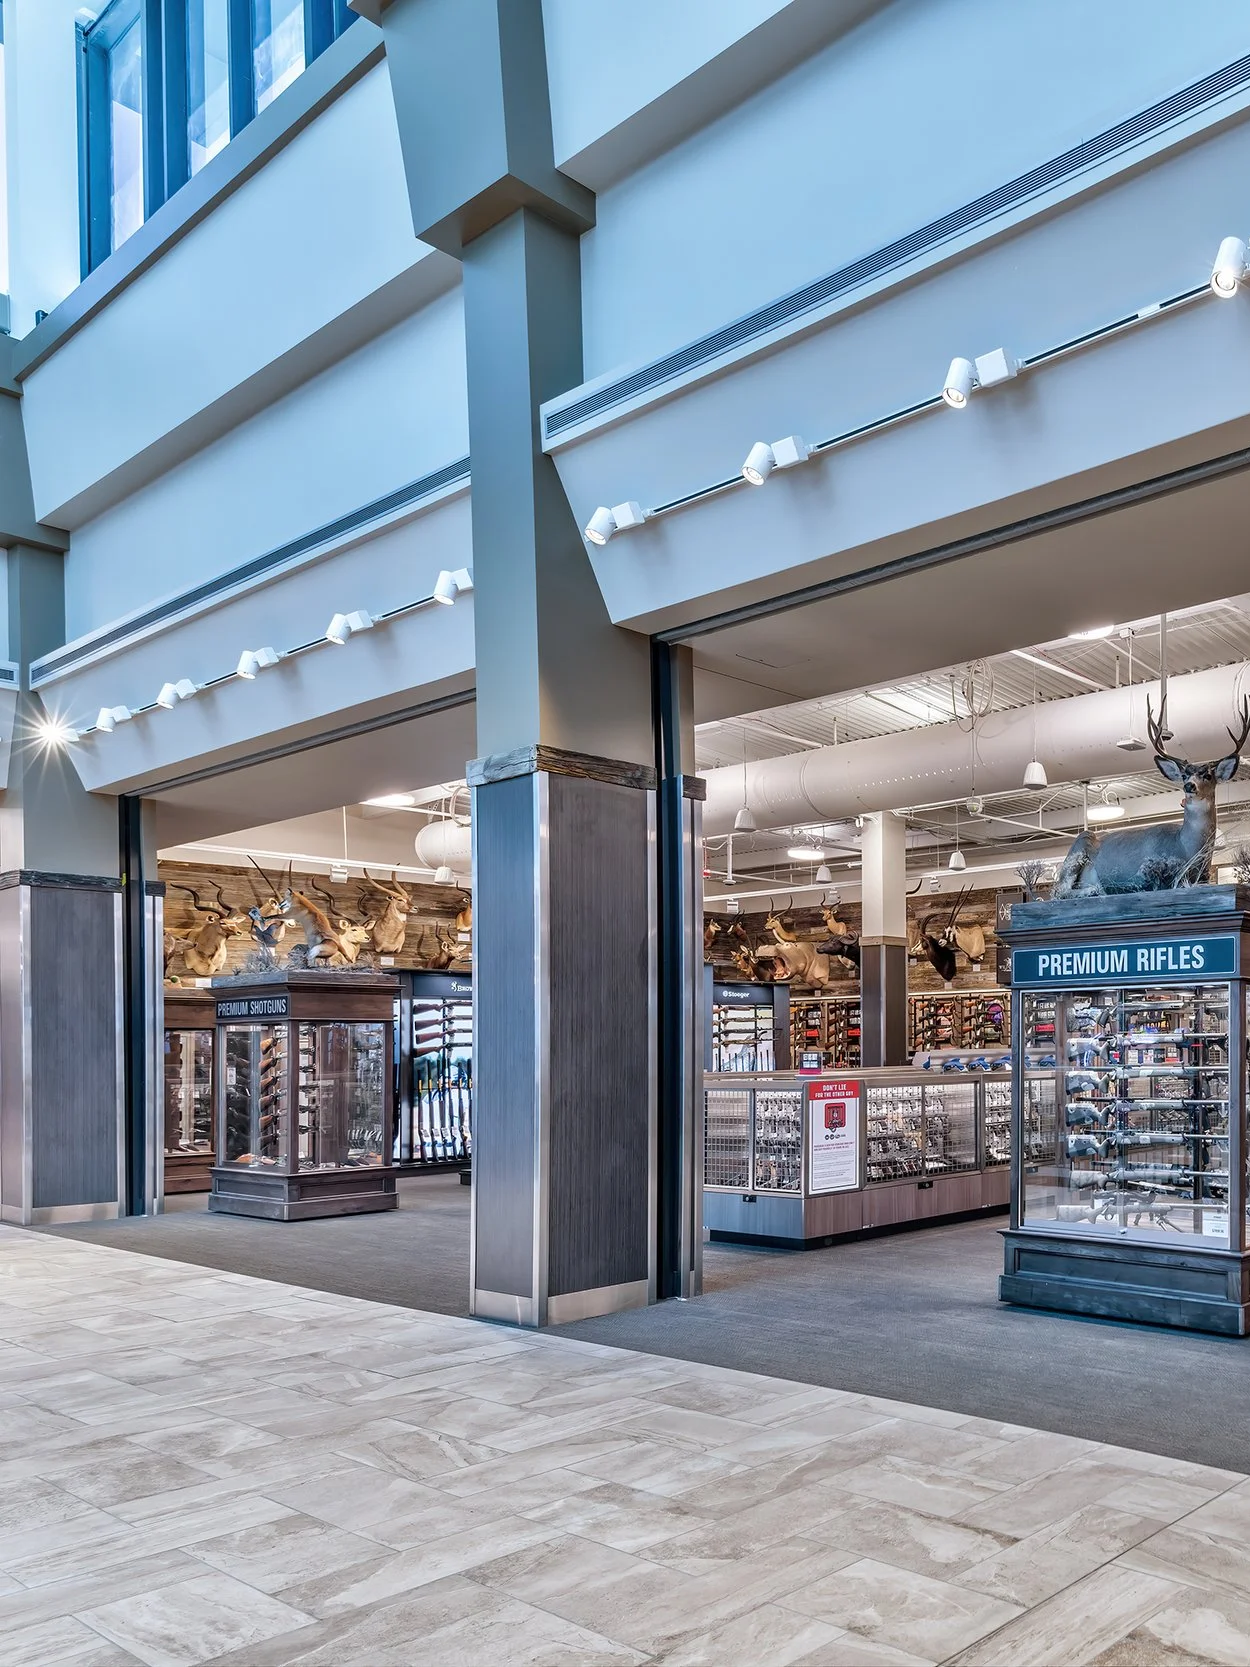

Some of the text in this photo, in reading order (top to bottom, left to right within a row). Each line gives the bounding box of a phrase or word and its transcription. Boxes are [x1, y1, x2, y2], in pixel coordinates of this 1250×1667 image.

[1038, 944, 1205, 977] PREMIUM RIFLES
[217, 998, 287, 1016] PREMIUM SHOTGUNS
[822, 1083, 838, 1091] DON'T
